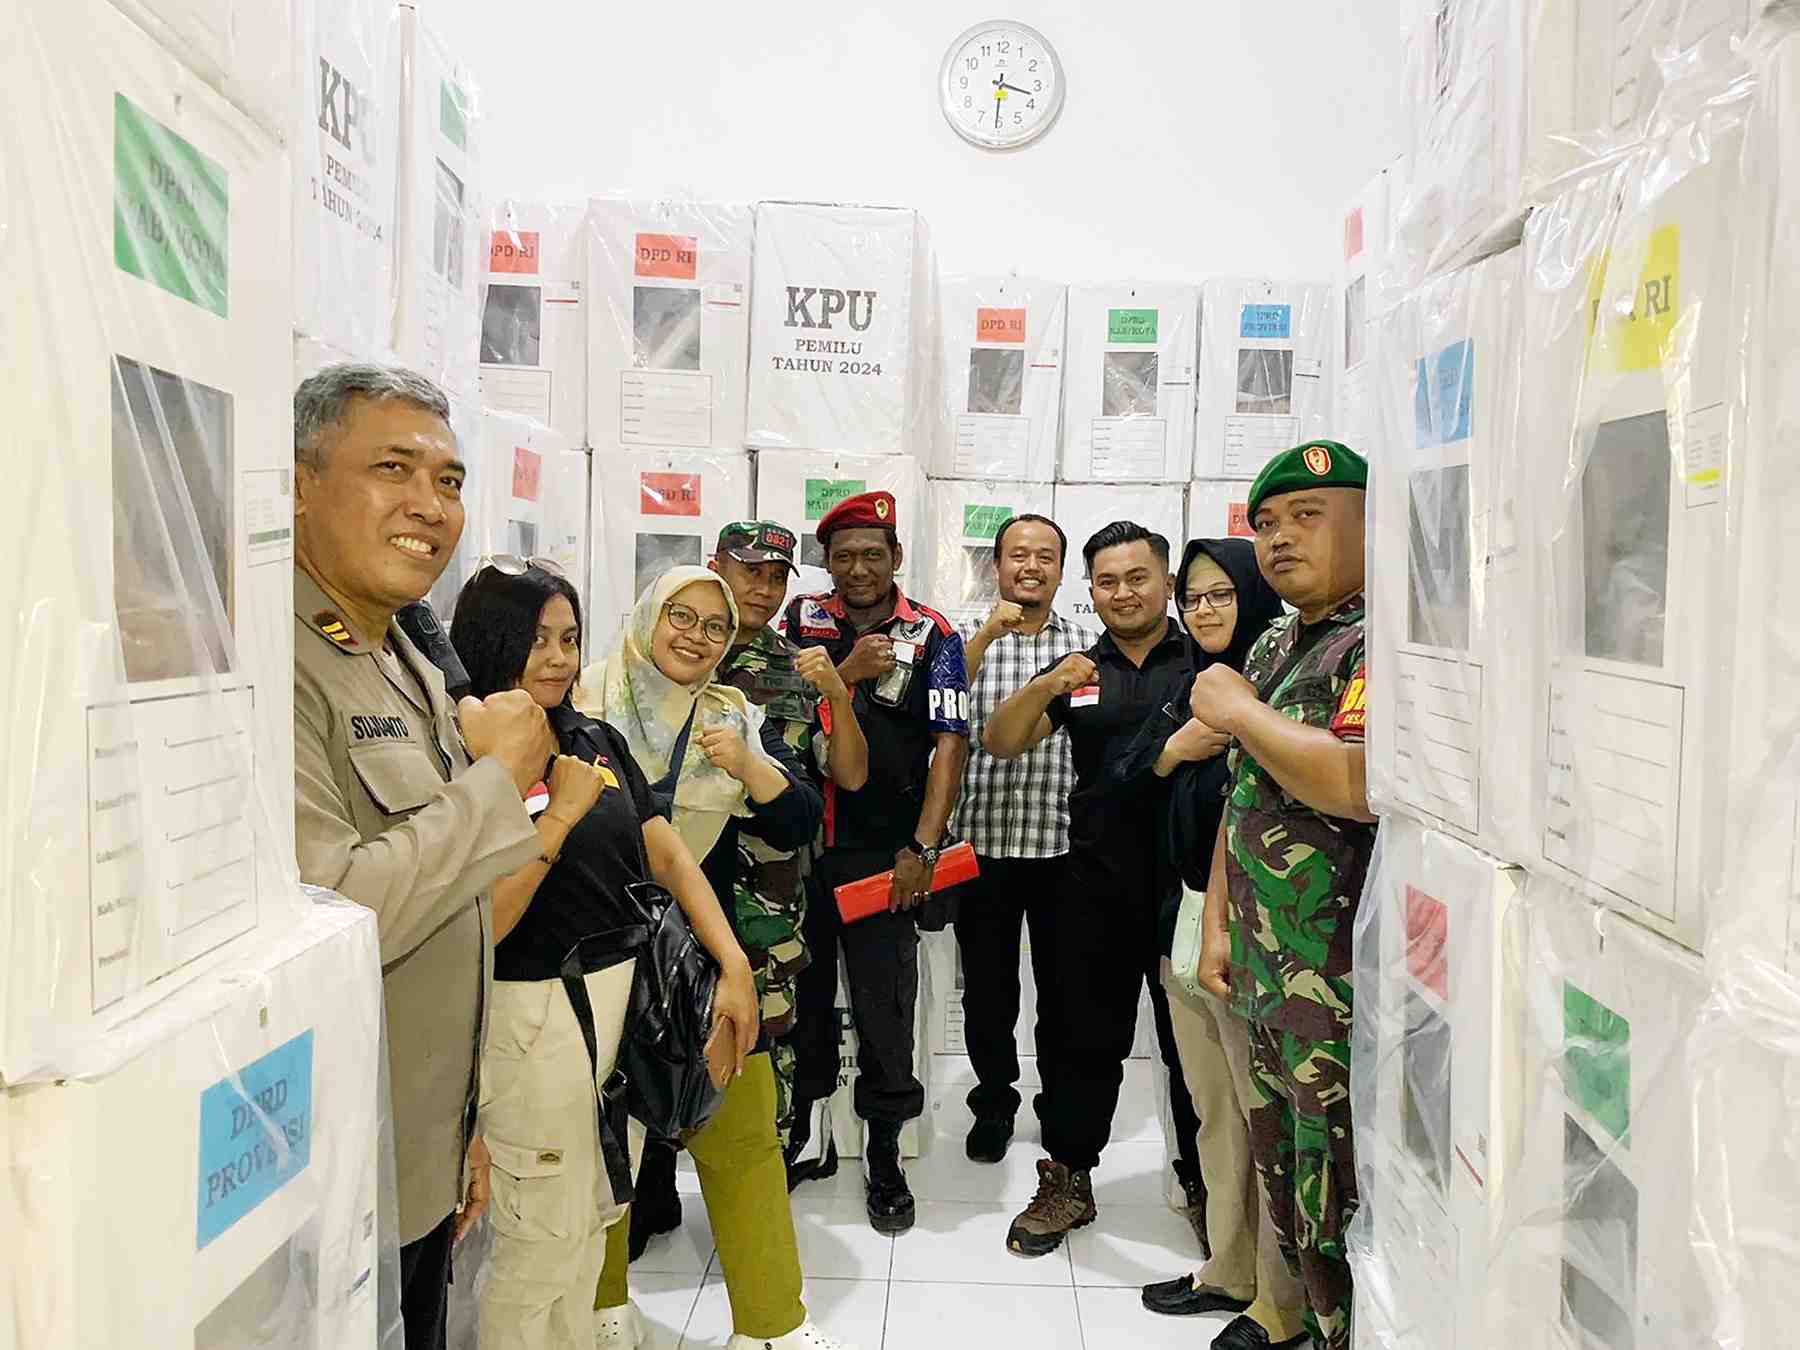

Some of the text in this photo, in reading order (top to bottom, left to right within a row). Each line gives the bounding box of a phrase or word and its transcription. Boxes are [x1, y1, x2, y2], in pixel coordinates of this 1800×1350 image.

[981, 45, 991, 56] 11
[997, 40, 1010, 54] 12
[1018, 46, 1023, 58] 1
[966, 57, 978, 70] 10
[1028, 59, 1038, 72] 2
[960, 76, 969, 89] 9
[1033, 79, 1042, 92] 3
[963, 95, 973, 108] 8
[1026, 98, 1035, 110] 4
[978, 110, 986, 123] 7
[995, 116, 1003, 129] 6
[1013, 111, 1022, 124] 5
[640, 247, 693, 264] DPD RI
[784, 286, 877, 331] KPU
[981, 319, 1006, 330] DPD
[795, 339, 863, 355] PEMILU
[771, 356, 882, 376] TAHUN 2024
